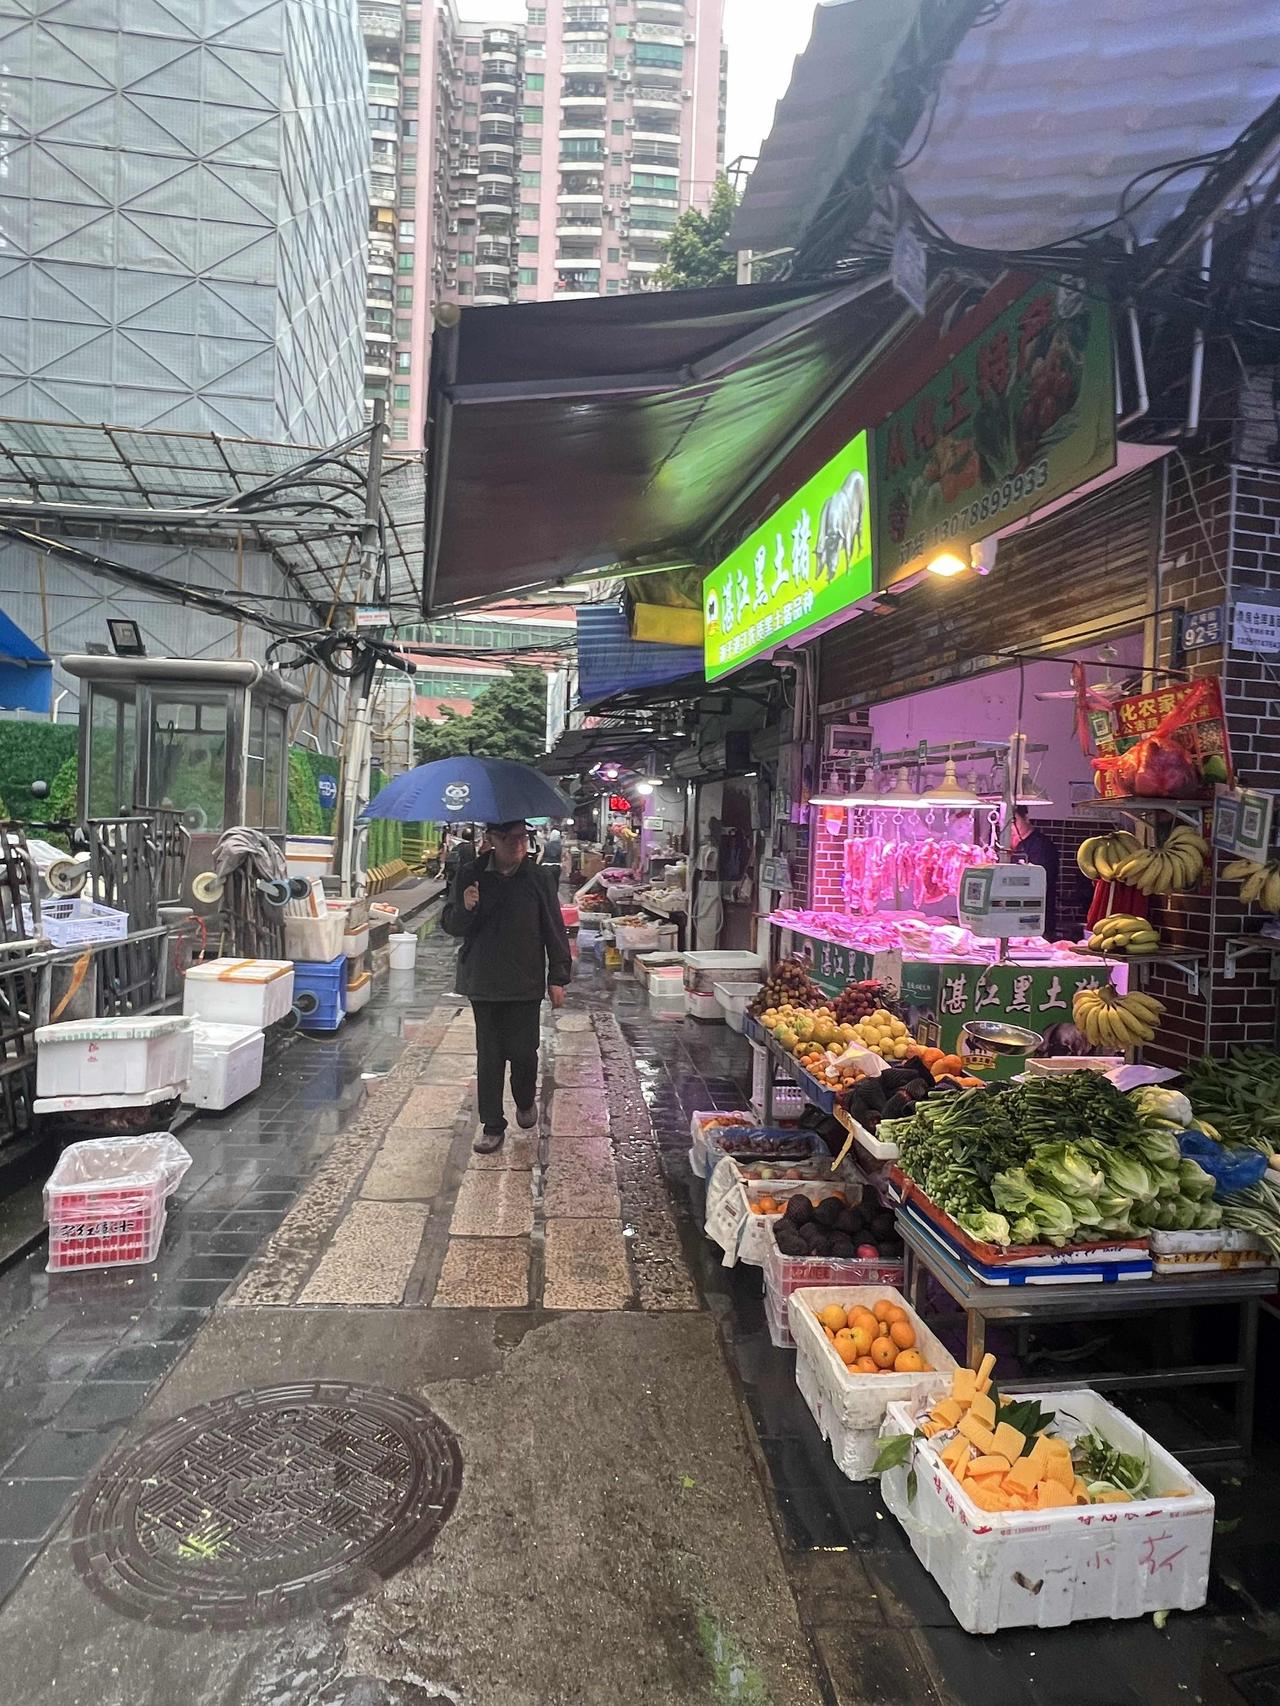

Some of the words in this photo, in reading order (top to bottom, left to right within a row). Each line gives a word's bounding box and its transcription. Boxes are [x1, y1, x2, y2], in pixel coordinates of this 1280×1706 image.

[932, 459, 1050, 543] 13078899933
[721, 507, 812, 635] 湛江黑土猪
[1185, 622, 1220, 646] 92号
